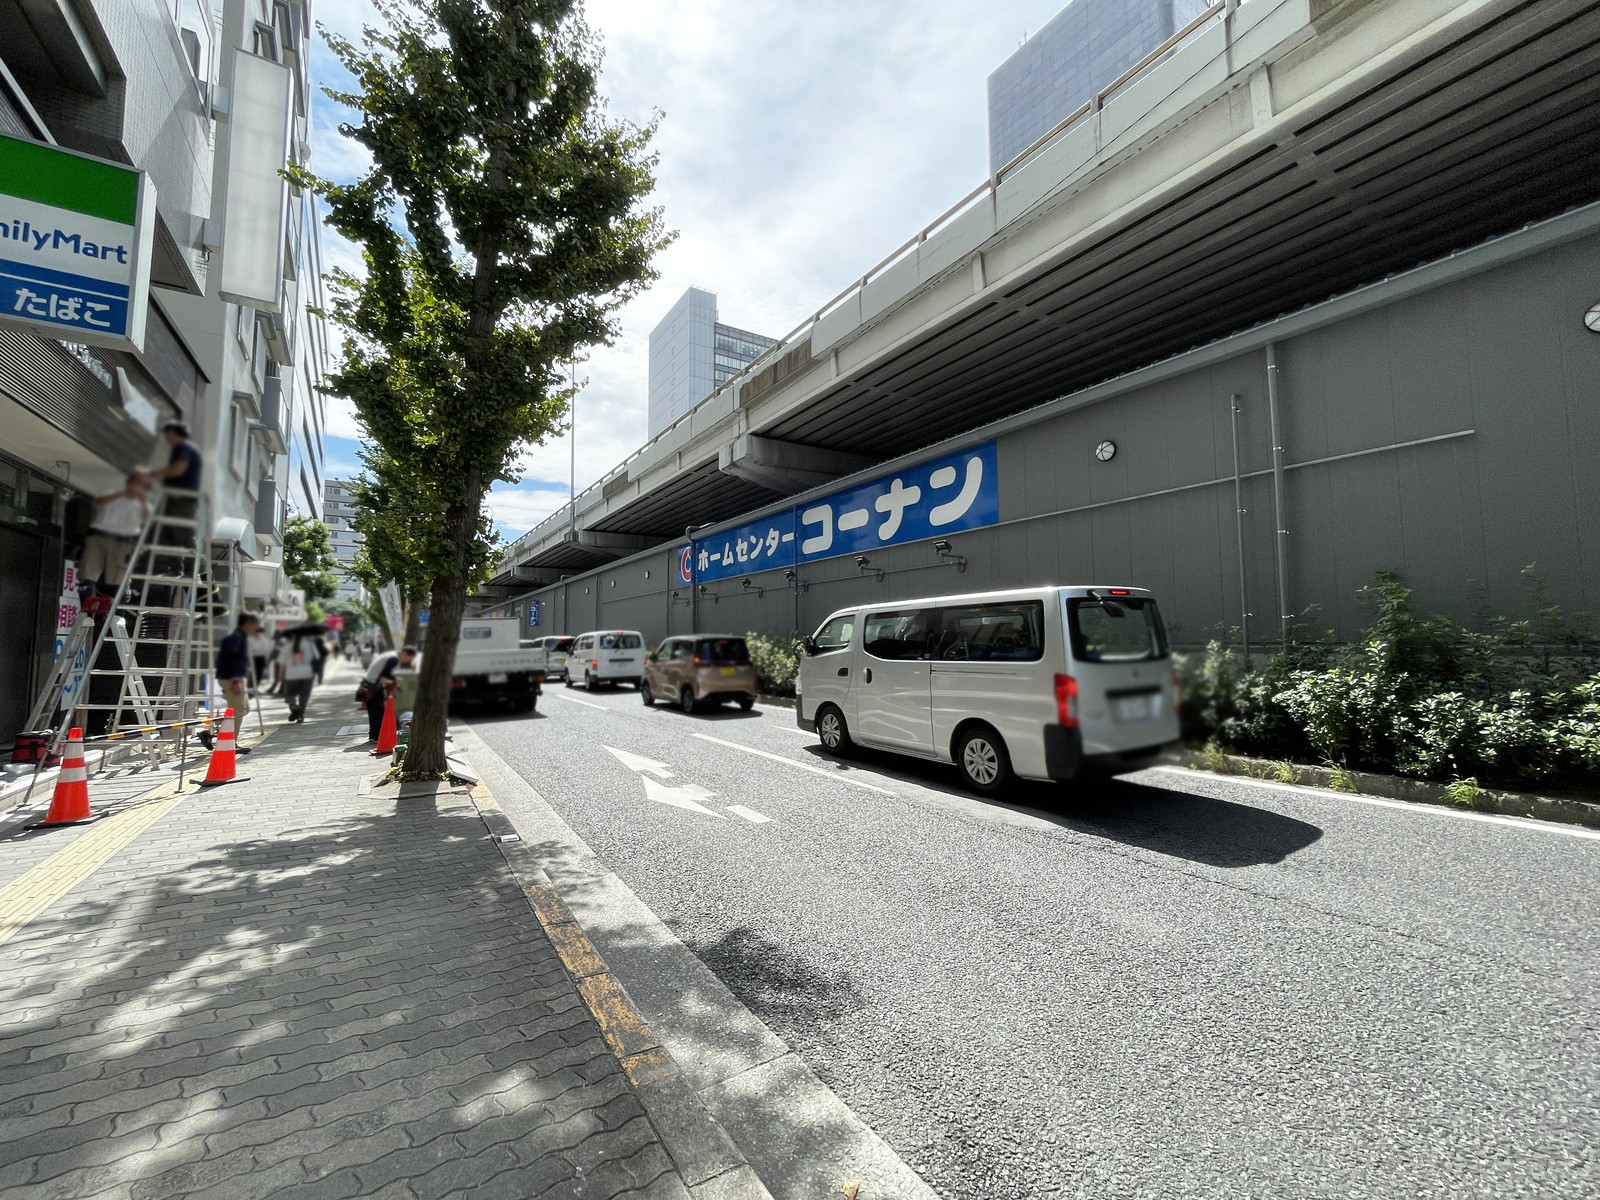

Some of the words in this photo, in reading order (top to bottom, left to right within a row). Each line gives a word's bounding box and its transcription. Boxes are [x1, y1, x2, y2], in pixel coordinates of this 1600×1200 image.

[14, 287, 110, 327] たばこ
[698, 527, 795, 572] ホームセンター
[801, 456, 983, 555] コーナン
